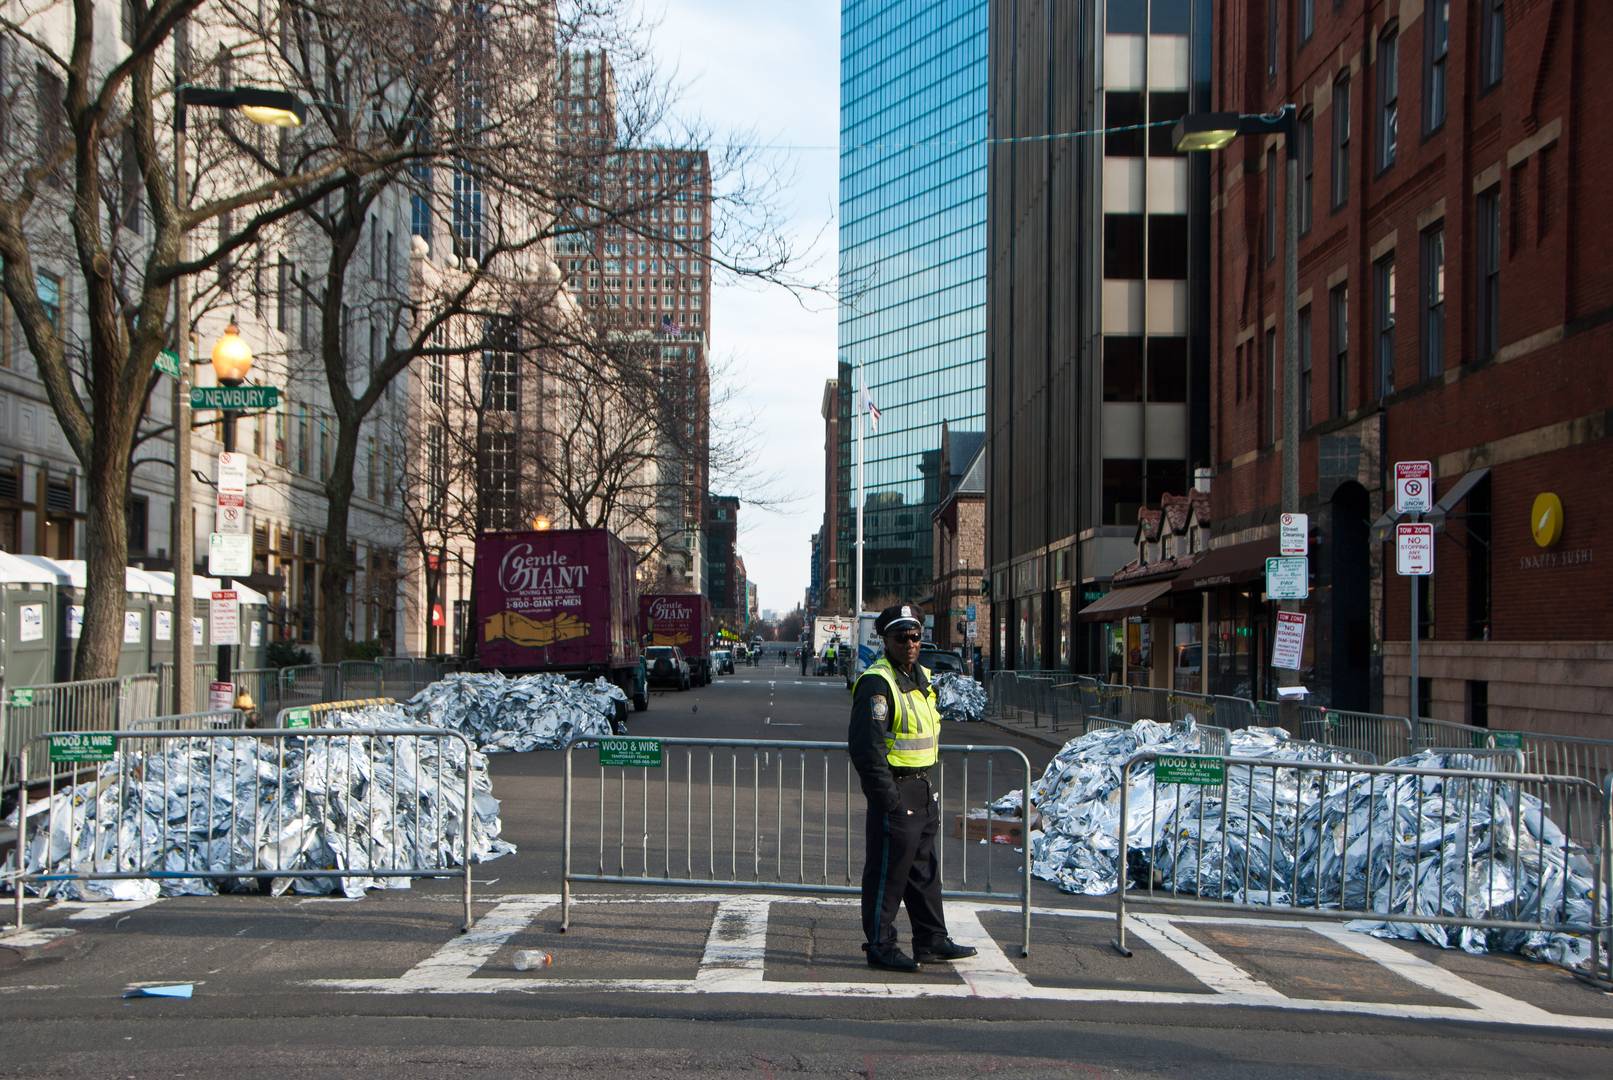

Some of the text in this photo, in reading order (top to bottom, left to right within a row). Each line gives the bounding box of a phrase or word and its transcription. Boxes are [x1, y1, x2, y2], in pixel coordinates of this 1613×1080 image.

[205, 389, 266, 407] NEWBURY
[1269, 560, 1278, 569] 2
[506, 599, 583, 608] 1-800-GIANT-MEN
[53, 736, 113, 746] WOOD & WIRE
[602, 741, 659, 752] WOOD & WIRE
[1159, 757, 1220, 770] WOOD & WIRE
